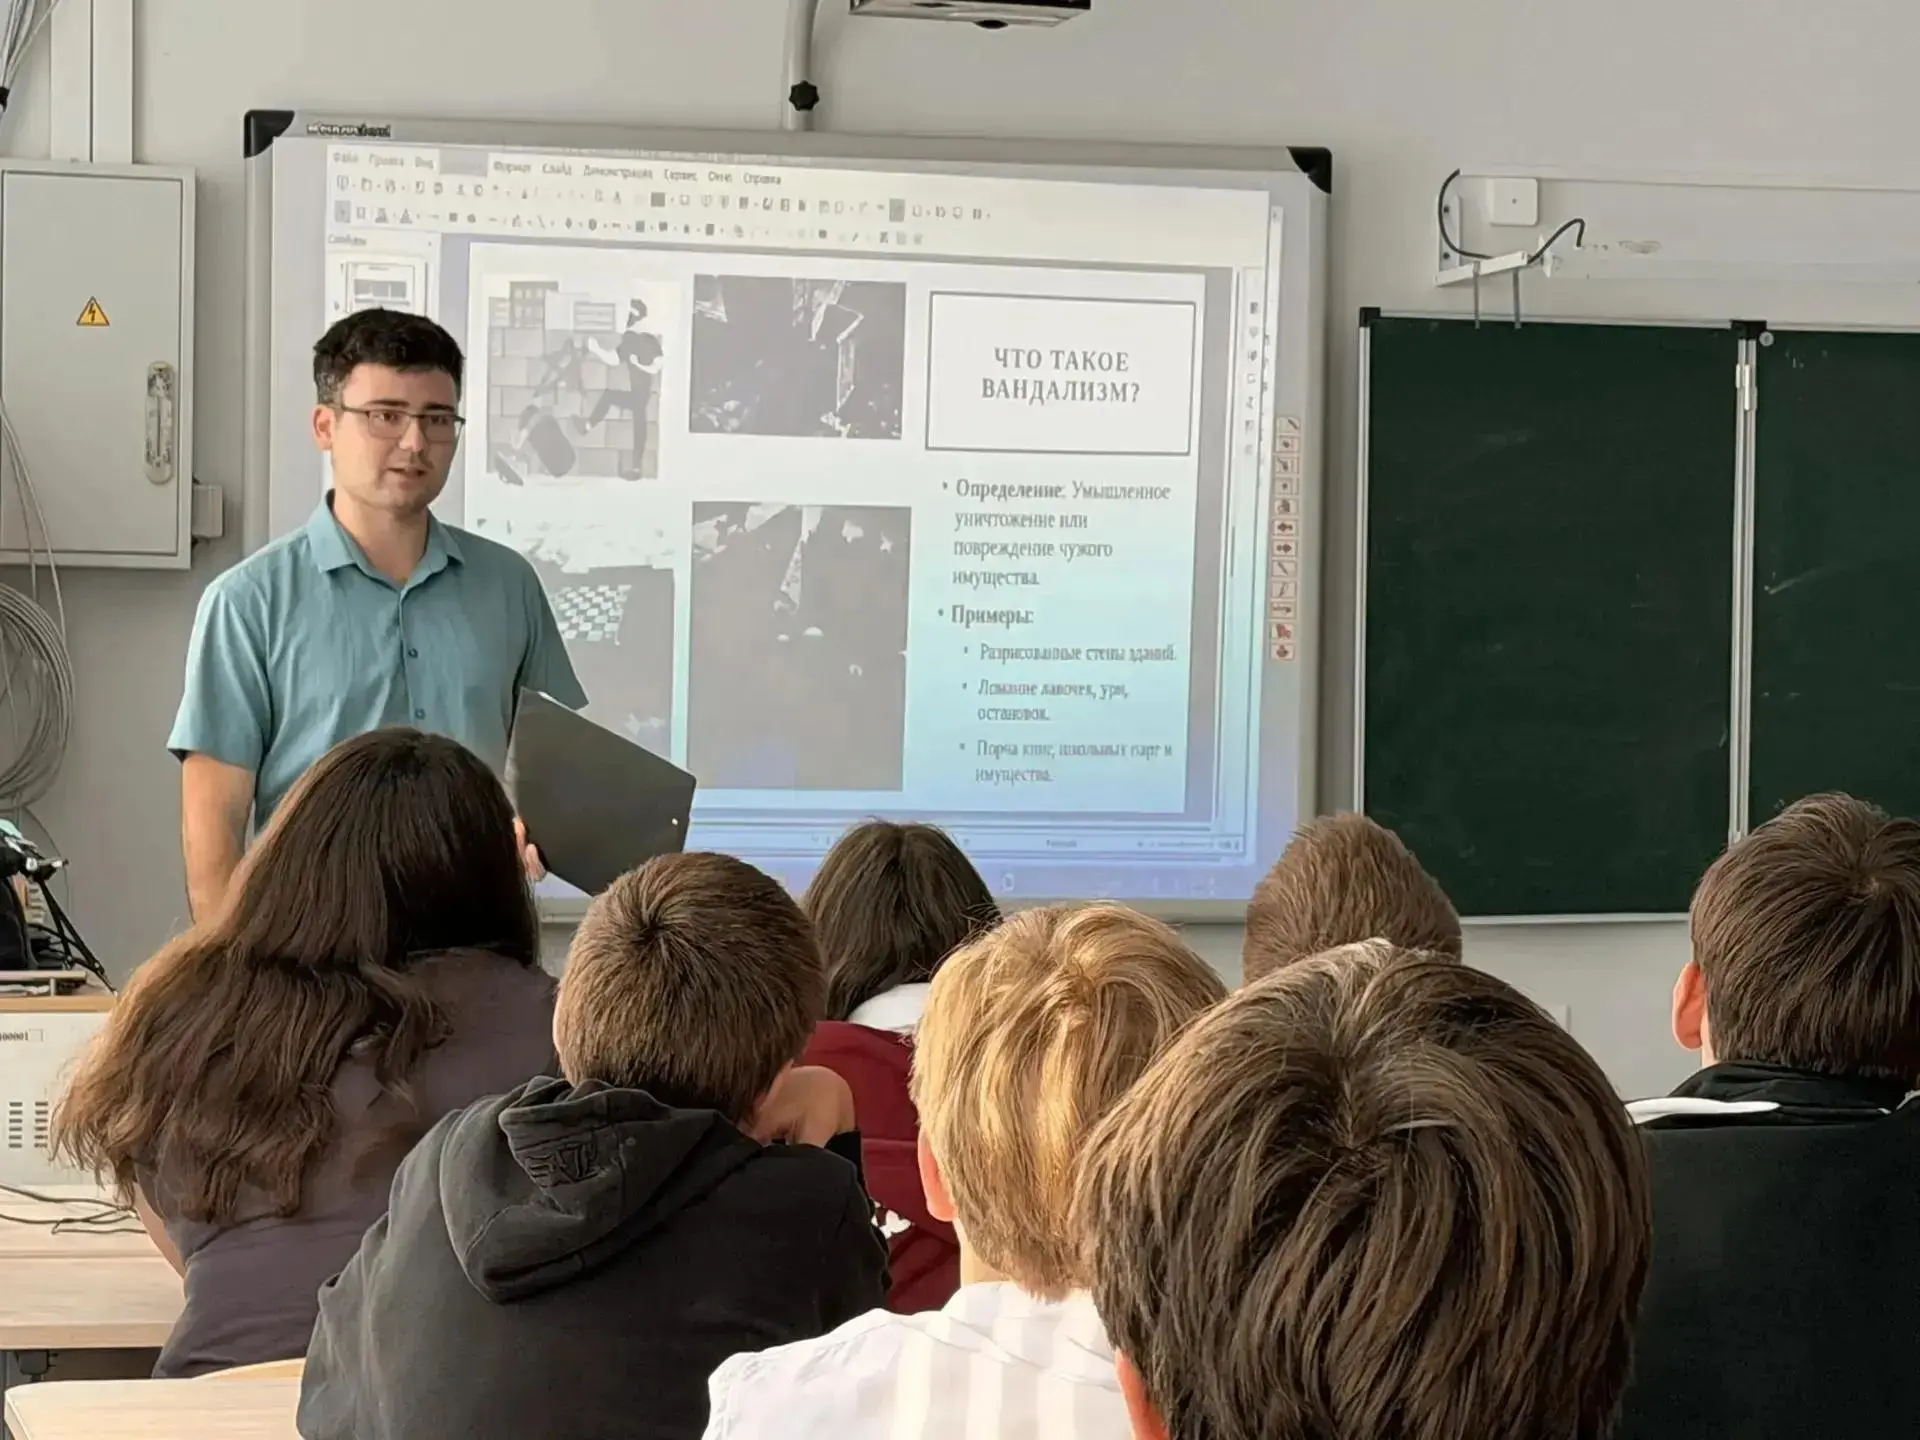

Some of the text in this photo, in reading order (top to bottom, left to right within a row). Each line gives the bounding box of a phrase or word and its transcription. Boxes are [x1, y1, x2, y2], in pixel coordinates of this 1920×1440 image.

[994, 347, 1130, 372] ЧТО ТАКОЕ
[981, 377, 1141, 405] ВАНДАЛИЗМ?
[1072, 480, 1171, 500] Умышленное
[954, 511, 1088, 532] уничтожение или
[953, 540, 1113, 563] повреждение чужого
[952, 569, 1040, 590] имущества.
[951, 604, 1034, 629] Примеры:
[980, 643, 1081, 665] Разрисованные
[1086, 647, 1125, 661] стены
[977, 739, 1018, 760] Порча
